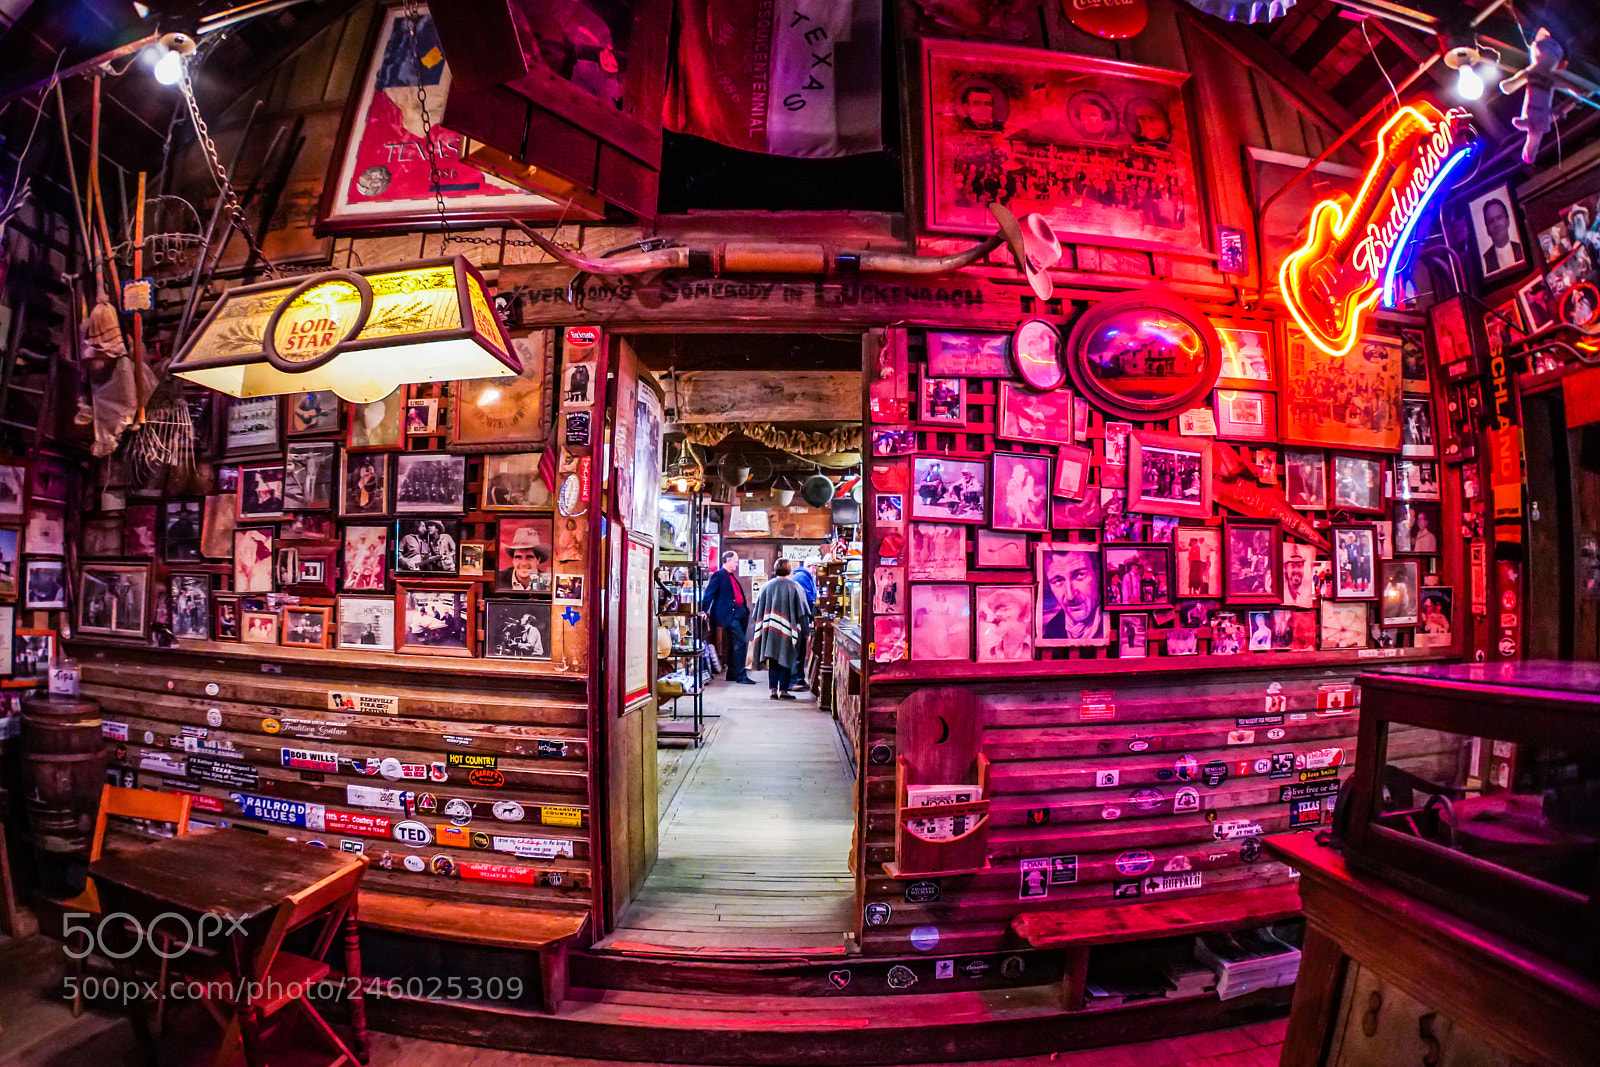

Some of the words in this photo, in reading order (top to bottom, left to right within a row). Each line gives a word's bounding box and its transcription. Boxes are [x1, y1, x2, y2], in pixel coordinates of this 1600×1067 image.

[783, 11, 833, 112] TEXAS
[1352, 112, 1464, 280] Budweiser
[291, 318, 337, 335] LONE
[285, 332, 334, 350] STAR
[54, 670, 74, 683] Tips
[282, 723, 315, 732] Tradition
[319, 725, 347, 736] Guitars
[290, 751, 307, 760] BOB
[309, 753, 336, 763] WILLS
[449, 754, 464, 764] HOT
[465, 755, 496, 766] COUNTRY
[212, 766, 232, 775] TEXAS
[1240, 763, 1248, 774] 7
[1257, 763, 1268, 771] CH
[1292, 787, 1305, 796] live
[1306, 785, 1319, 794] free
[1328, 782, 1339, 791] die
[246, 797, 305, 815] RAILROAD
[1298, 800, 1320, 813] TEXAS
[255, 807, 297, 822] BLUES
[1299, 810, 1321, 822] MUSIC
[398, 827, 427, 842] TED
[1162, 875, 1201, 890] BUFFALO
